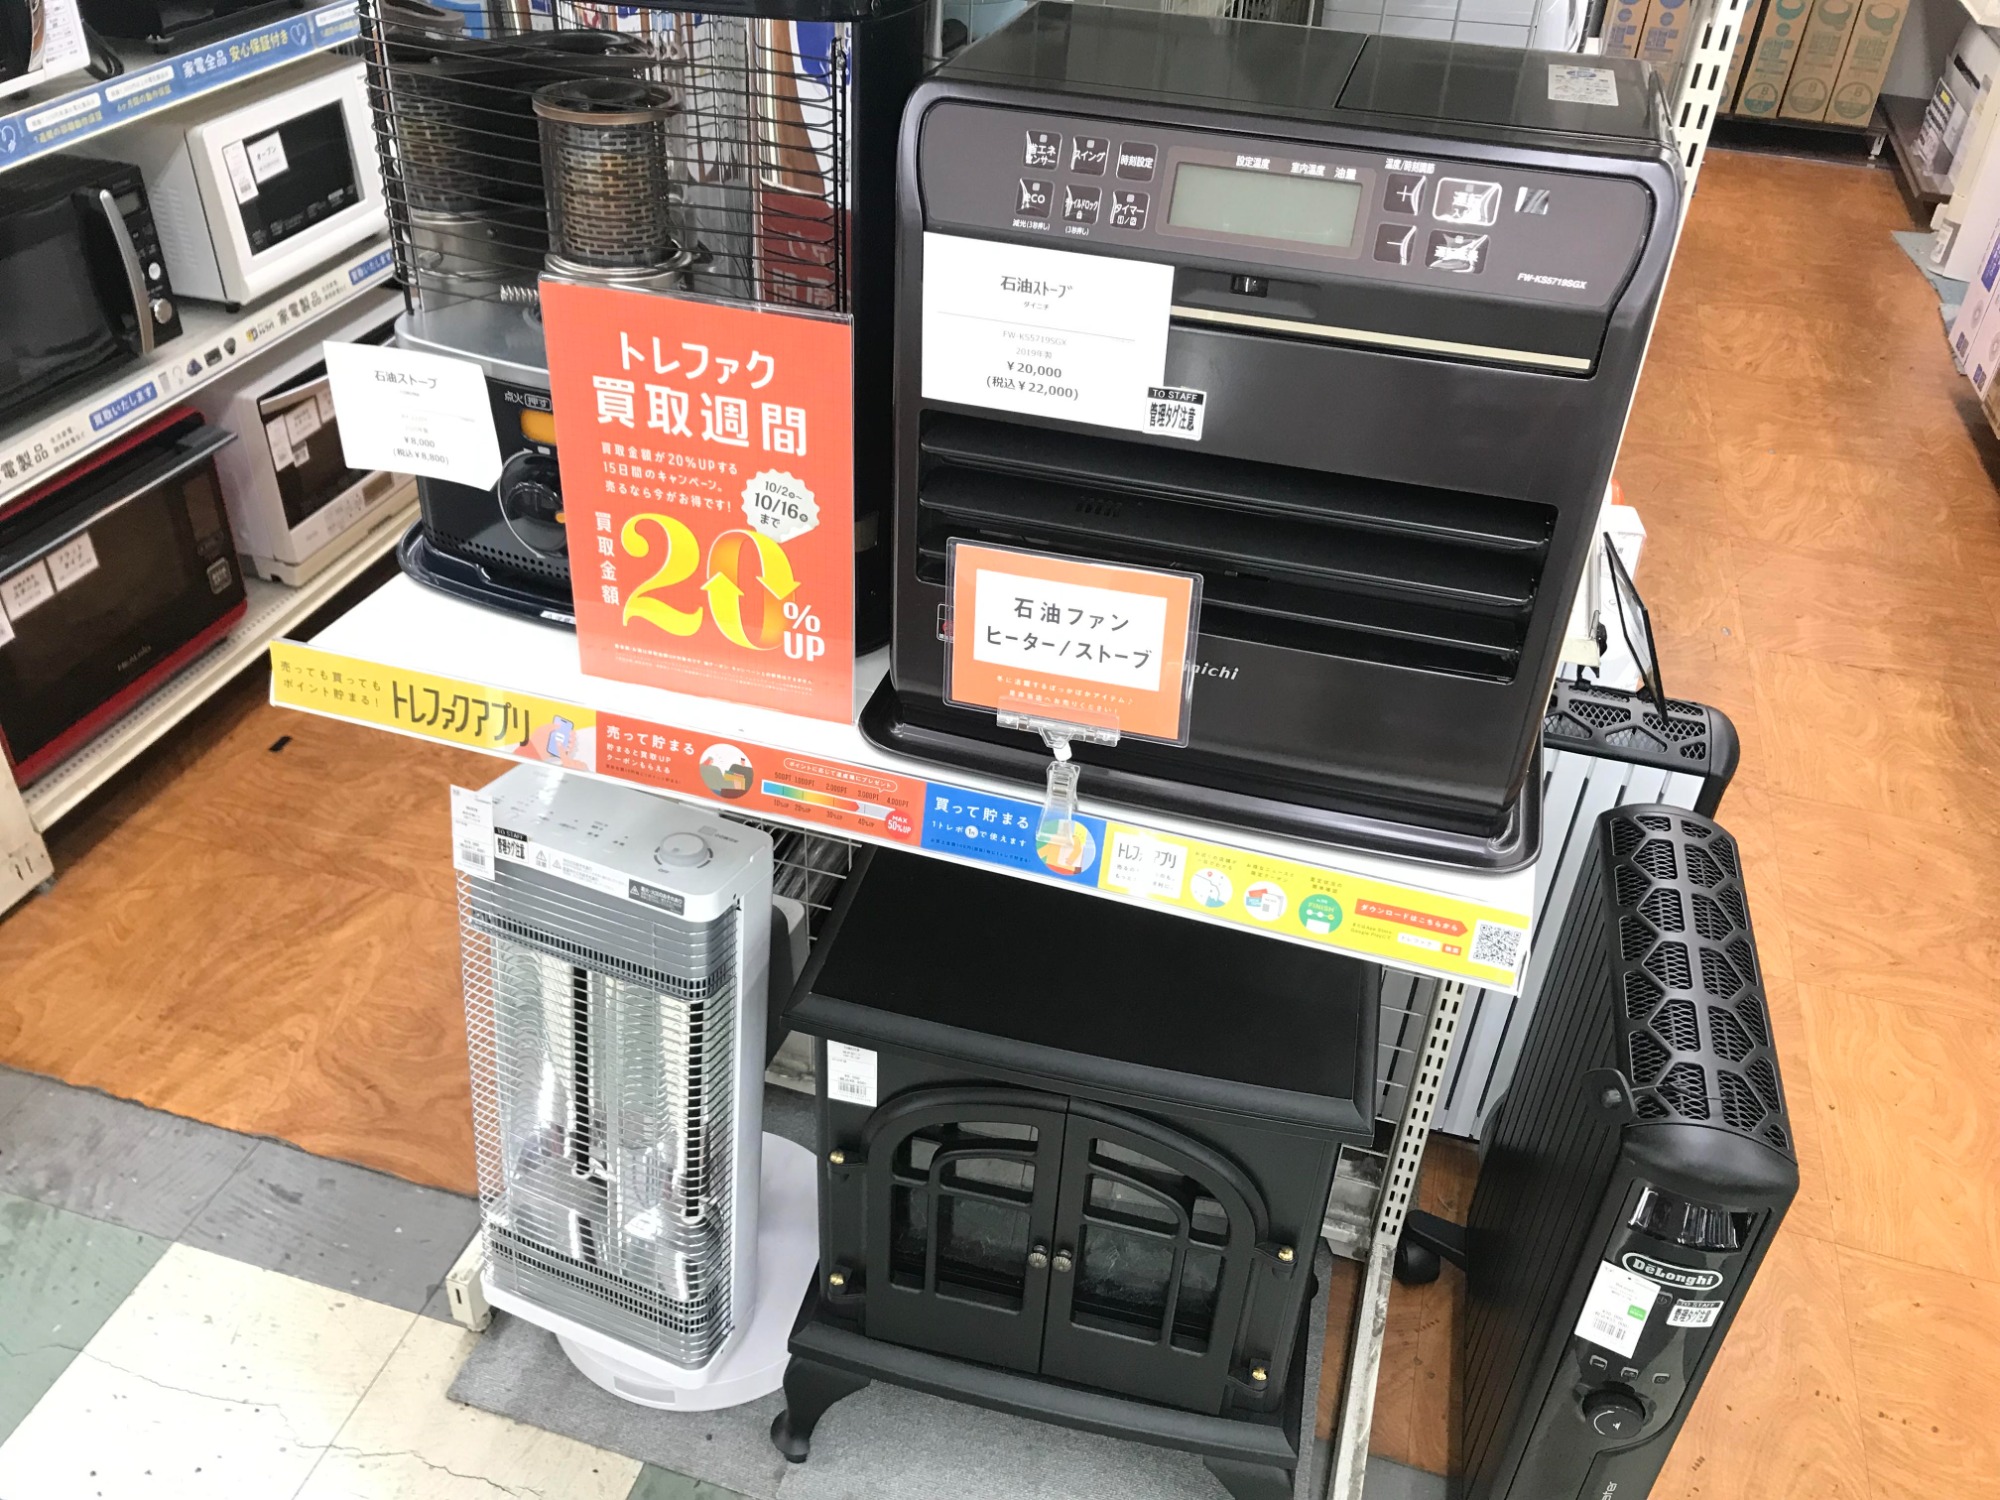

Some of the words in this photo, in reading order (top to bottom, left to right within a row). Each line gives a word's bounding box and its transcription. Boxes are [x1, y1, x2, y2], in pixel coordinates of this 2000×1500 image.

[1236, 155, 1270, 170] 設定温度
[1334, 167, 1356, 181] 油量
[1517, 273, 1588, 290] FW-KS5719SGX
[619, 331, 775, 390] トレファク
[374, 370, 438, 389] 石油ストーブ
[1152, 388, 1166, 399] TO
[1168, 390, 1199, 403] STAFF
[592, 375, 807, 457] 買取週間
[0, 443, 49, 484] 電製品
[601, 442, 738, 475] 買取金額が20%UPする
[603, 461, 723, 493] 15日間のキャンペーン。
[605, 480, 732, 512] 売るなら今がお得です!
[760, 513, 781, 529] まで
[595, 511, 620, 606] 買取金額
[1014, 596, 1130, 632] 石油ファン
[783, 631, 826, 662] UP
[986, 625, 1153, 669] ヒーター/ストーブ
[280, 661, 382, 692] 売っても買っても
[283, 677, 380, 708] ポイント貯まる!
[392, 680, 530, 747] トレファクアプリ
[606, 725, 695, 756] 売って貯まる
[606, 754, 671, 775] クーポンもらえる
[934, 796, 1029, 829] 買って貯まる
